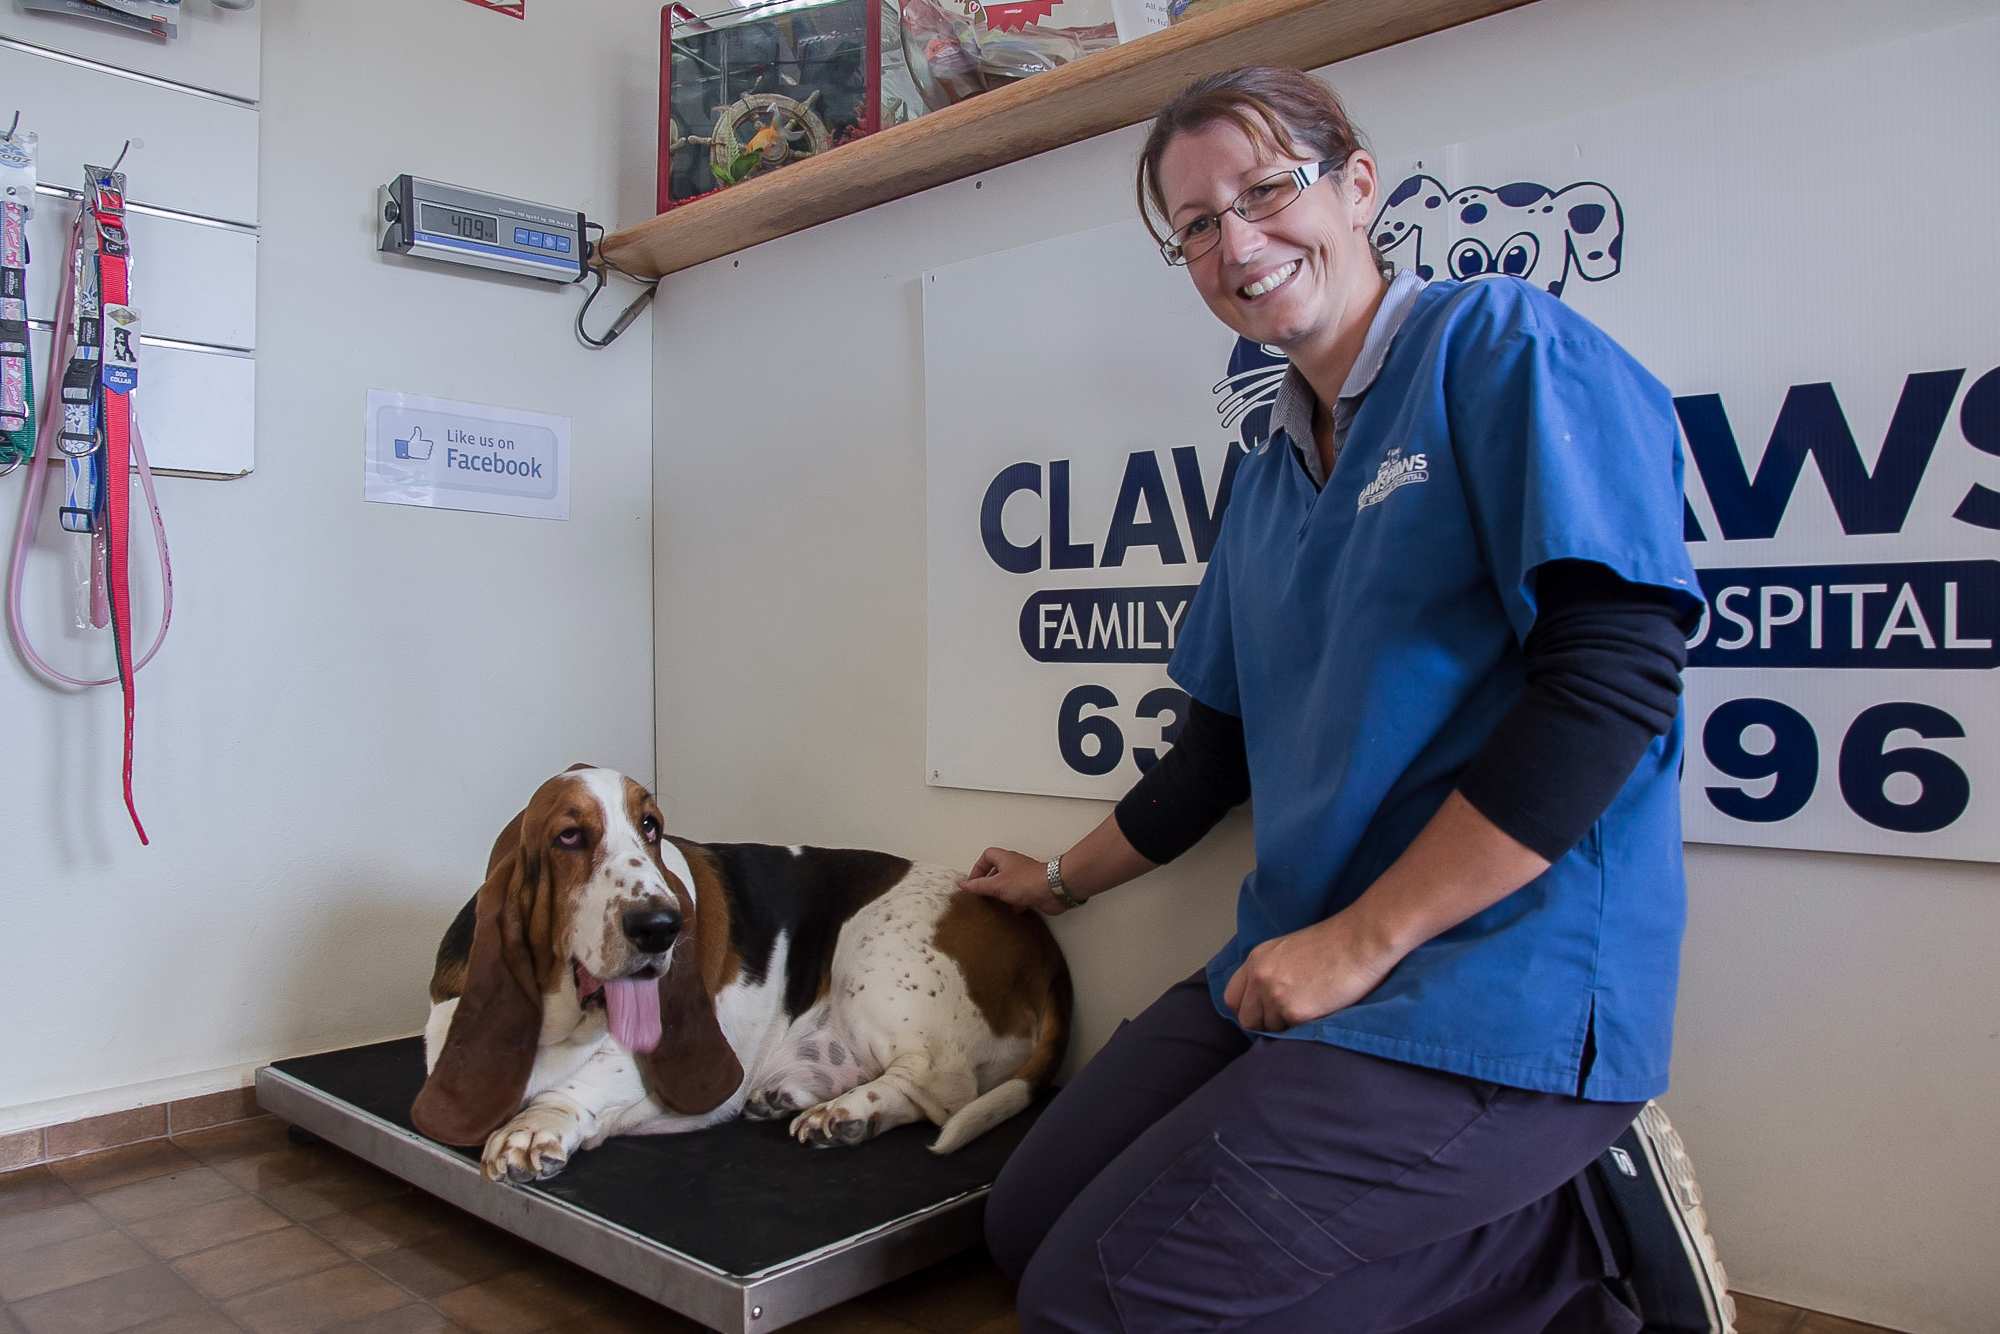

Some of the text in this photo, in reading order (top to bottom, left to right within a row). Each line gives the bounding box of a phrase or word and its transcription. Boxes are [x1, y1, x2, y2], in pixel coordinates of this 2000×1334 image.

[110, 376, 132, 385] COLLAR
[447, 429, 514, 450] Like us on
[447, 447, 543, 479] Facebook
[1039, 581, 1993, 650] FAMILY SPITAL
